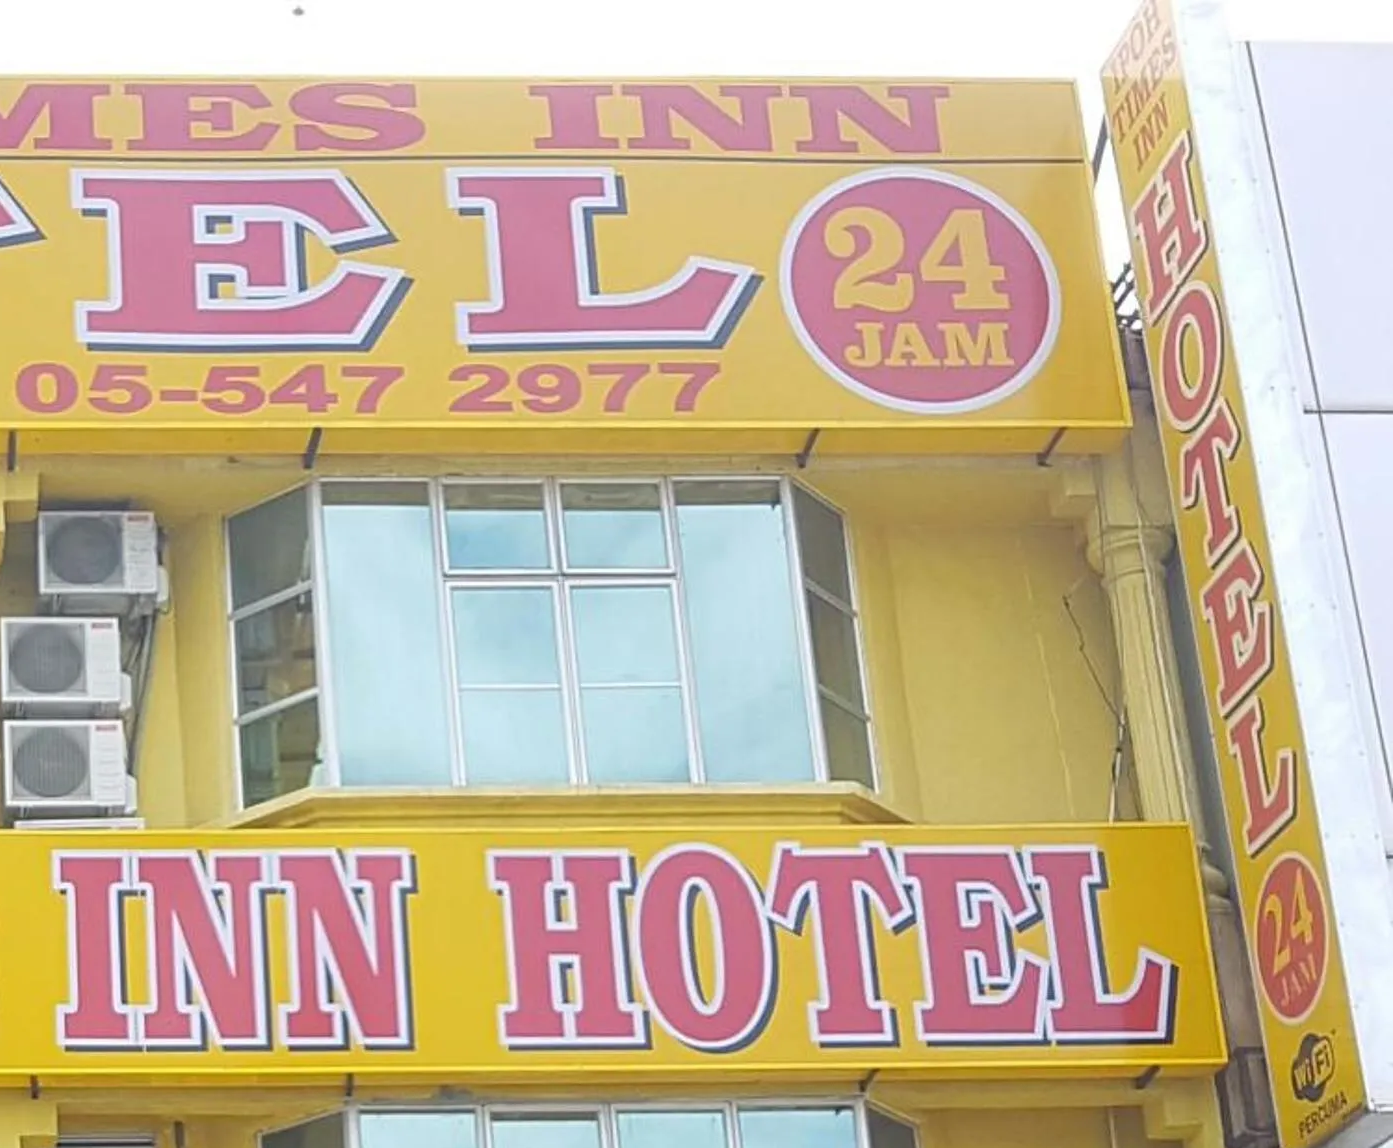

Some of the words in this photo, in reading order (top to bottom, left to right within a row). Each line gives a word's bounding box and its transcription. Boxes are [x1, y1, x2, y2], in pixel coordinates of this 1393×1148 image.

[1110, 0, 1161, 95] IPOH
[1111, 25, 1177, 146] TIMES
[528, 83, 950, 155] INN
[1132, 91, 1169, 173] INN
[822, 205, 1011, 312] 24
[14, 362, 404, 415] 05-547
[447, 361, 722, 415] 2977
[843, 320, 1016, 369] JAM
[1131, 129, 1298, 860] HOTEL
[51, 847, 420, 1053] INN
[486, 840, 1180, 1053] HOTEL
[1263, 866, 1314, 976] 24
[1279, 954, 1319, 1007] JAM
[1298, 1089, 1348, 1140] PERCUMA
